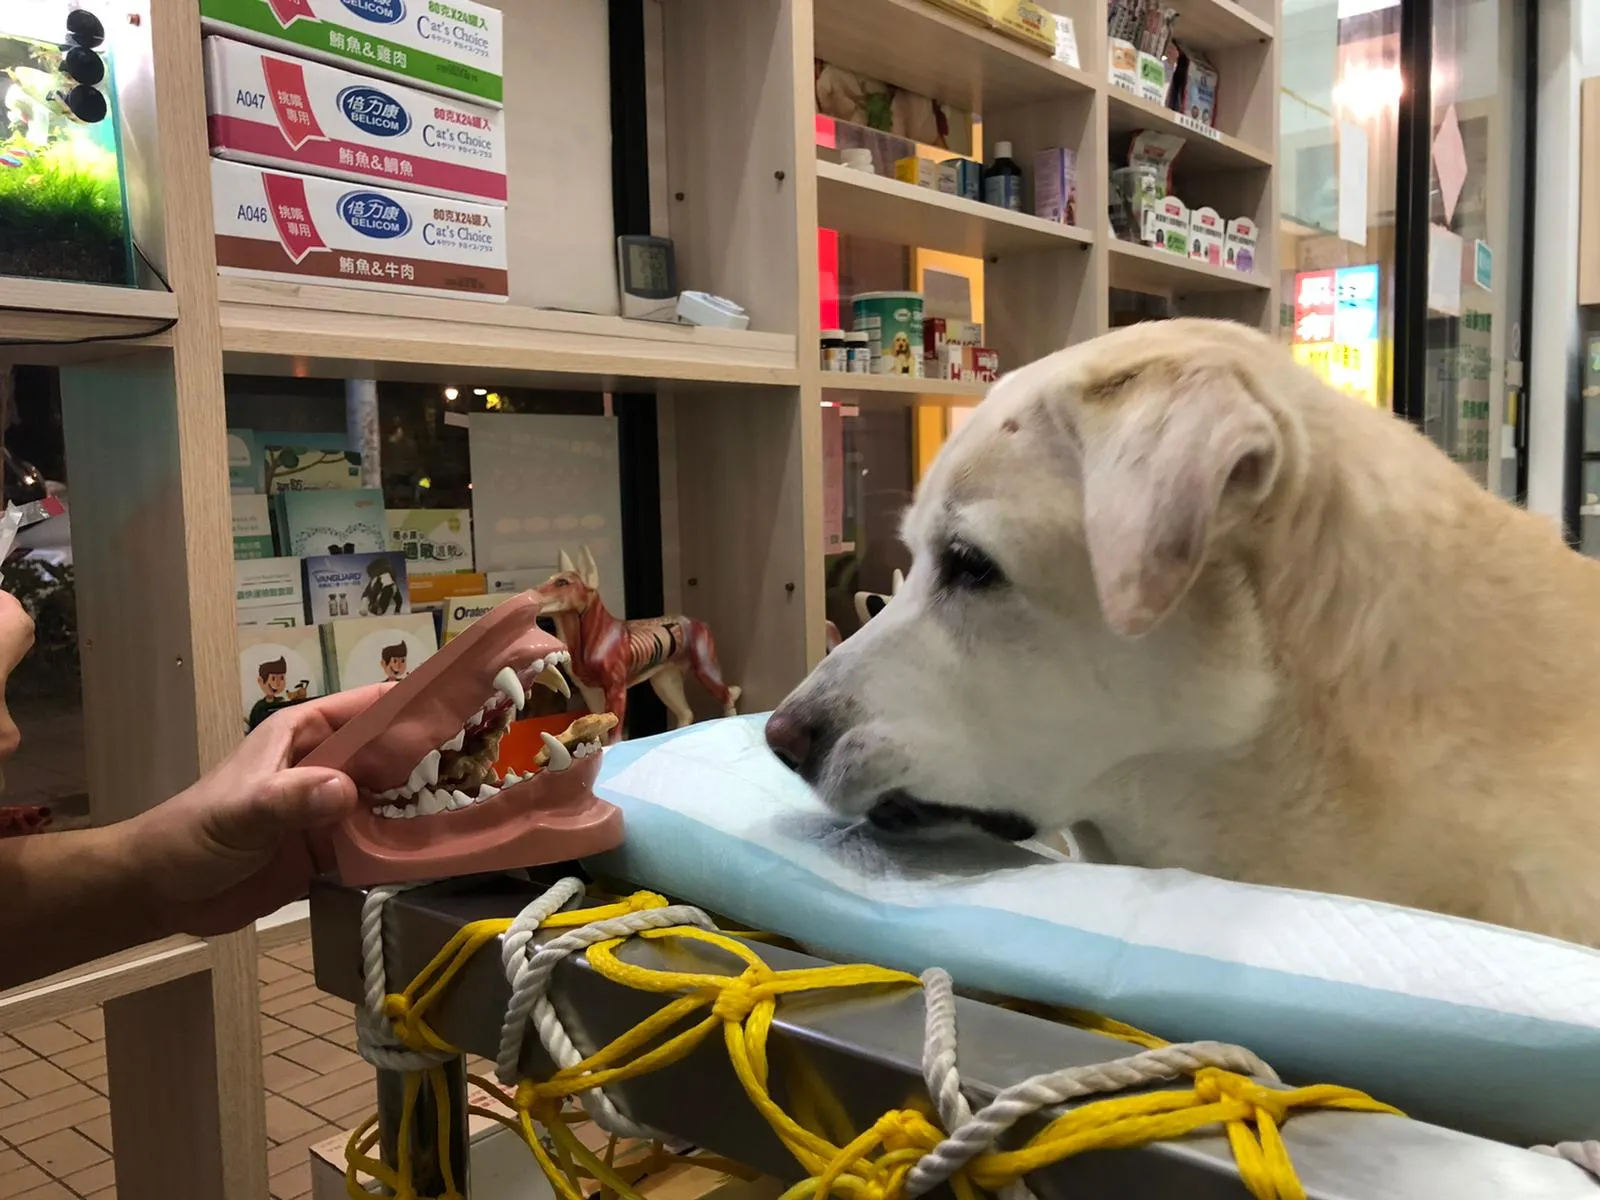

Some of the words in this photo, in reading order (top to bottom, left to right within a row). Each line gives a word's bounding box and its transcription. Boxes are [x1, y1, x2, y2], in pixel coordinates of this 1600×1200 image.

[417, 15, 450, 39] Cat's
[453, 26, 489, 49] Choice
[329, 30, 407, 69] 鮪魚&雞肉
[236, 89, 265, 109] A047
[347, 95, 400, 119] 倍力康
[286, 107, 310, 126] 專用
[351, 112, 399, 130] BELICOM
[423, 124, 455, 147] Cat's
[457, 131, 491, 149] Choice
[339, 147, 413, 178] 鮪魚&鯛魚
[237, 204, 267, 223] A046
[347, 200, 400, 221] 倍力康
[287, 221, 311, 238] 專用
[351, 217, 399, 231] BELICOM
[423, 223, 455, 245] Cat's
[457, 227, 492, 244] Choice
[339, 256, 414, 280] 鮪魚&牛肉
